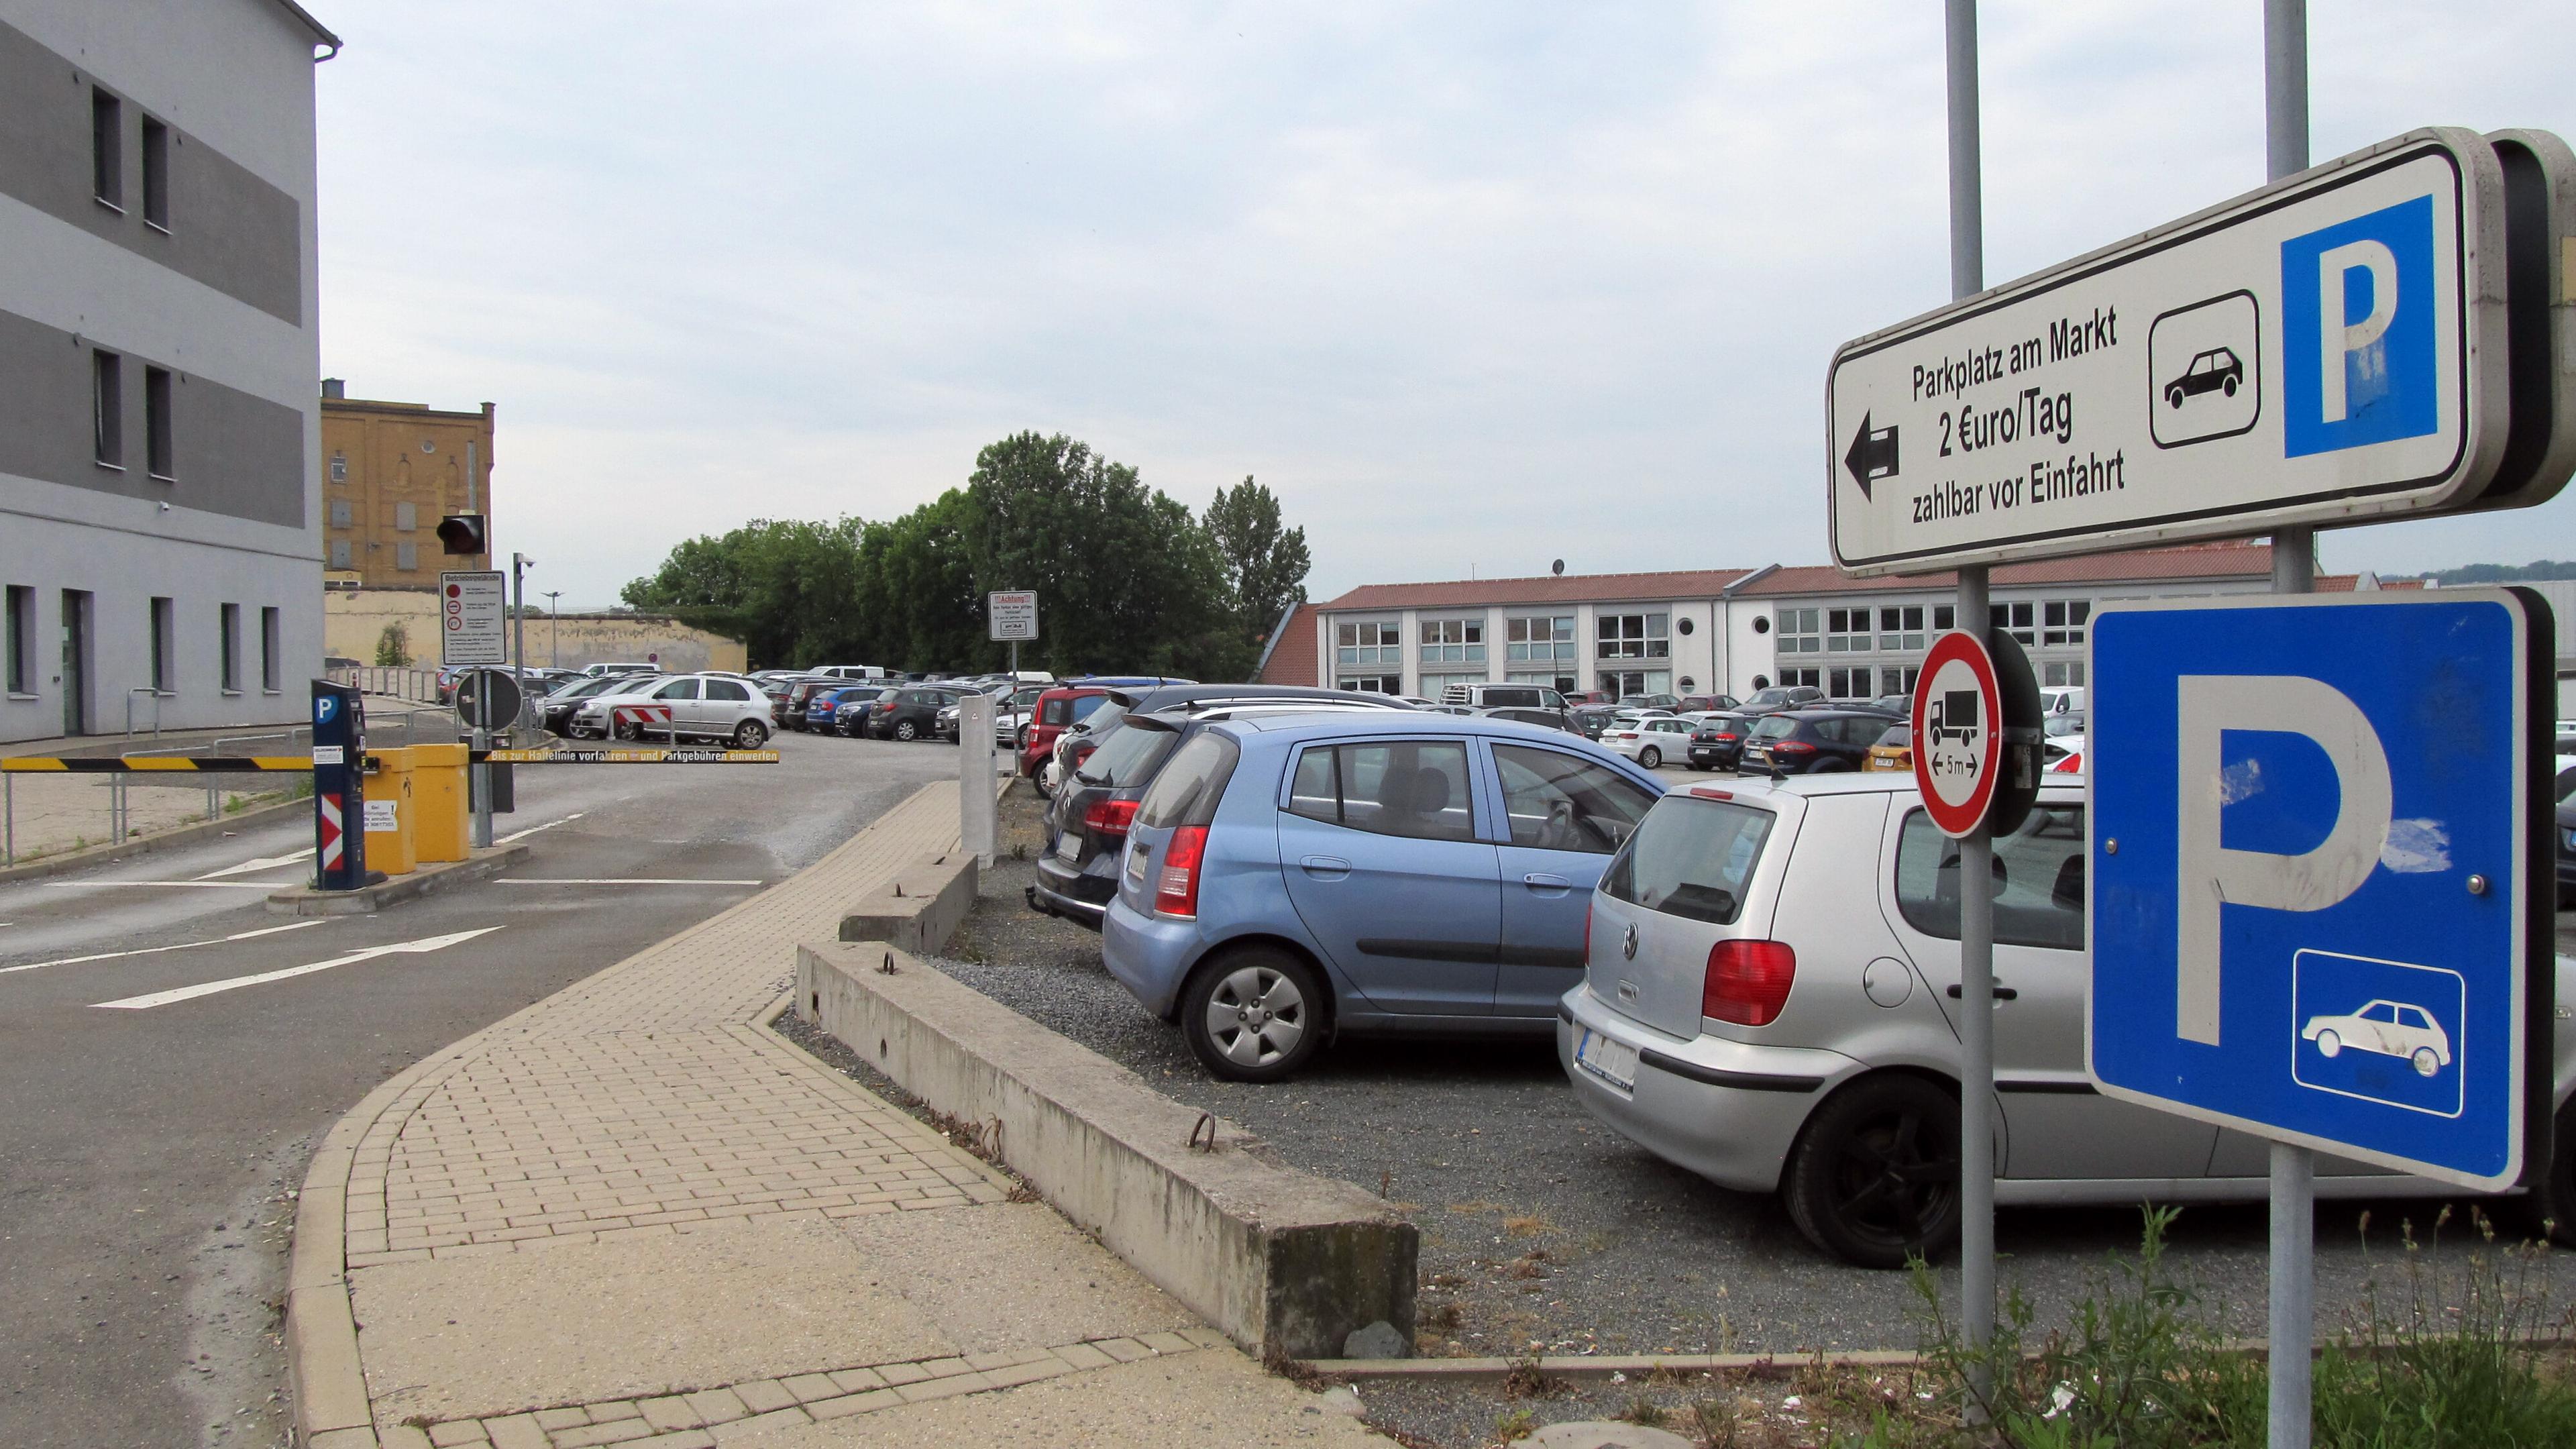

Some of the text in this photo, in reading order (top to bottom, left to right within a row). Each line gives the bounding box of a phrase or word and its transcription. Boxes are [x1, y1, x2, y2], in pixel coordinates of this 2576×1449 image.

[1913, 304, 2117, 402] Parkplatz am Markt
[2319, 239, 2398, 424] P
[1939, 386, 2072, 458] 2 €uro/Tag
[1913, 448, 2125, 523] zahlbar vor Einfahrt
[319, 698, 332, 718] P
[492, 751, 506, 761] Bis
[510, 752, 525, 761] zur
[529, 751, 576, 761] Haltelinie
[641, 751, 658, 761] und
[661, 751, 727, 762] Parkgebühren
[730, 751, 777, 761] einwerfen
[2178, 675, 2392, 1047] P
